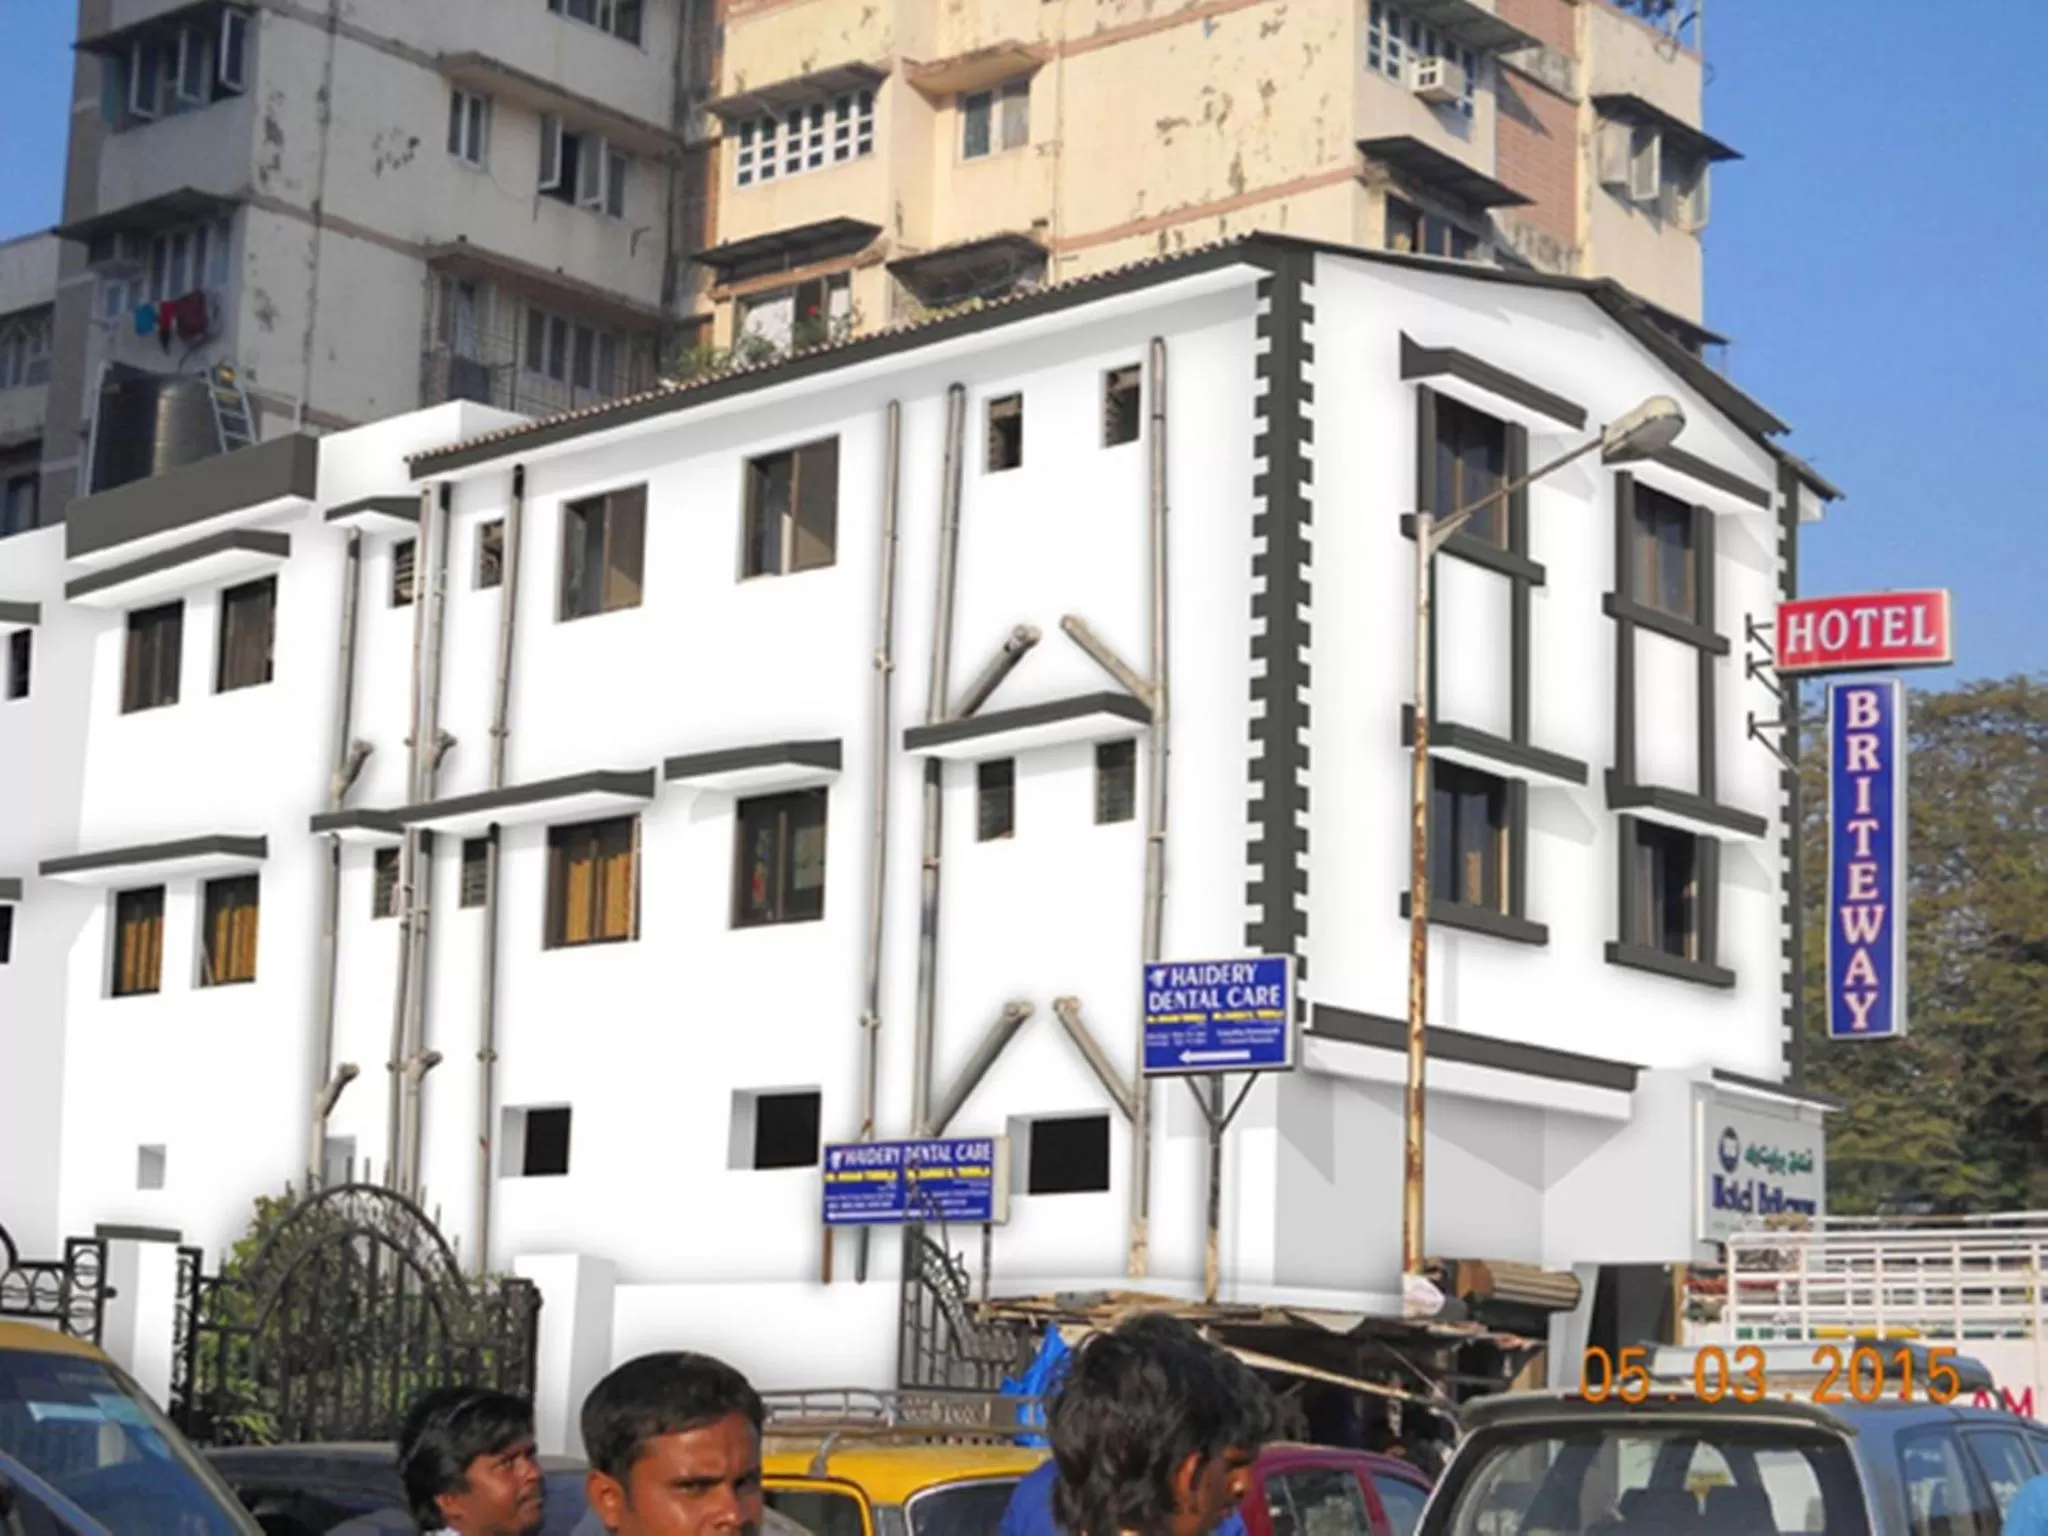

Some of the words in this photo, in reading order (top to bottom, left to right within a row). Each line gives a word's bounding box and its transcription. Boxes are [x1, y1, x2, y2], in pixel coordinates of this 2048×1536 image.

[1785, 605, 1937, 653] HOTEL
[1840, 689, 1886, 1031] BRITEWAY
[1171, 963, 1258, 987] HAIDERY
[1149, 987, 1222, 1012] DENTAL
[1226, 984, 1281, 1008] CARE
